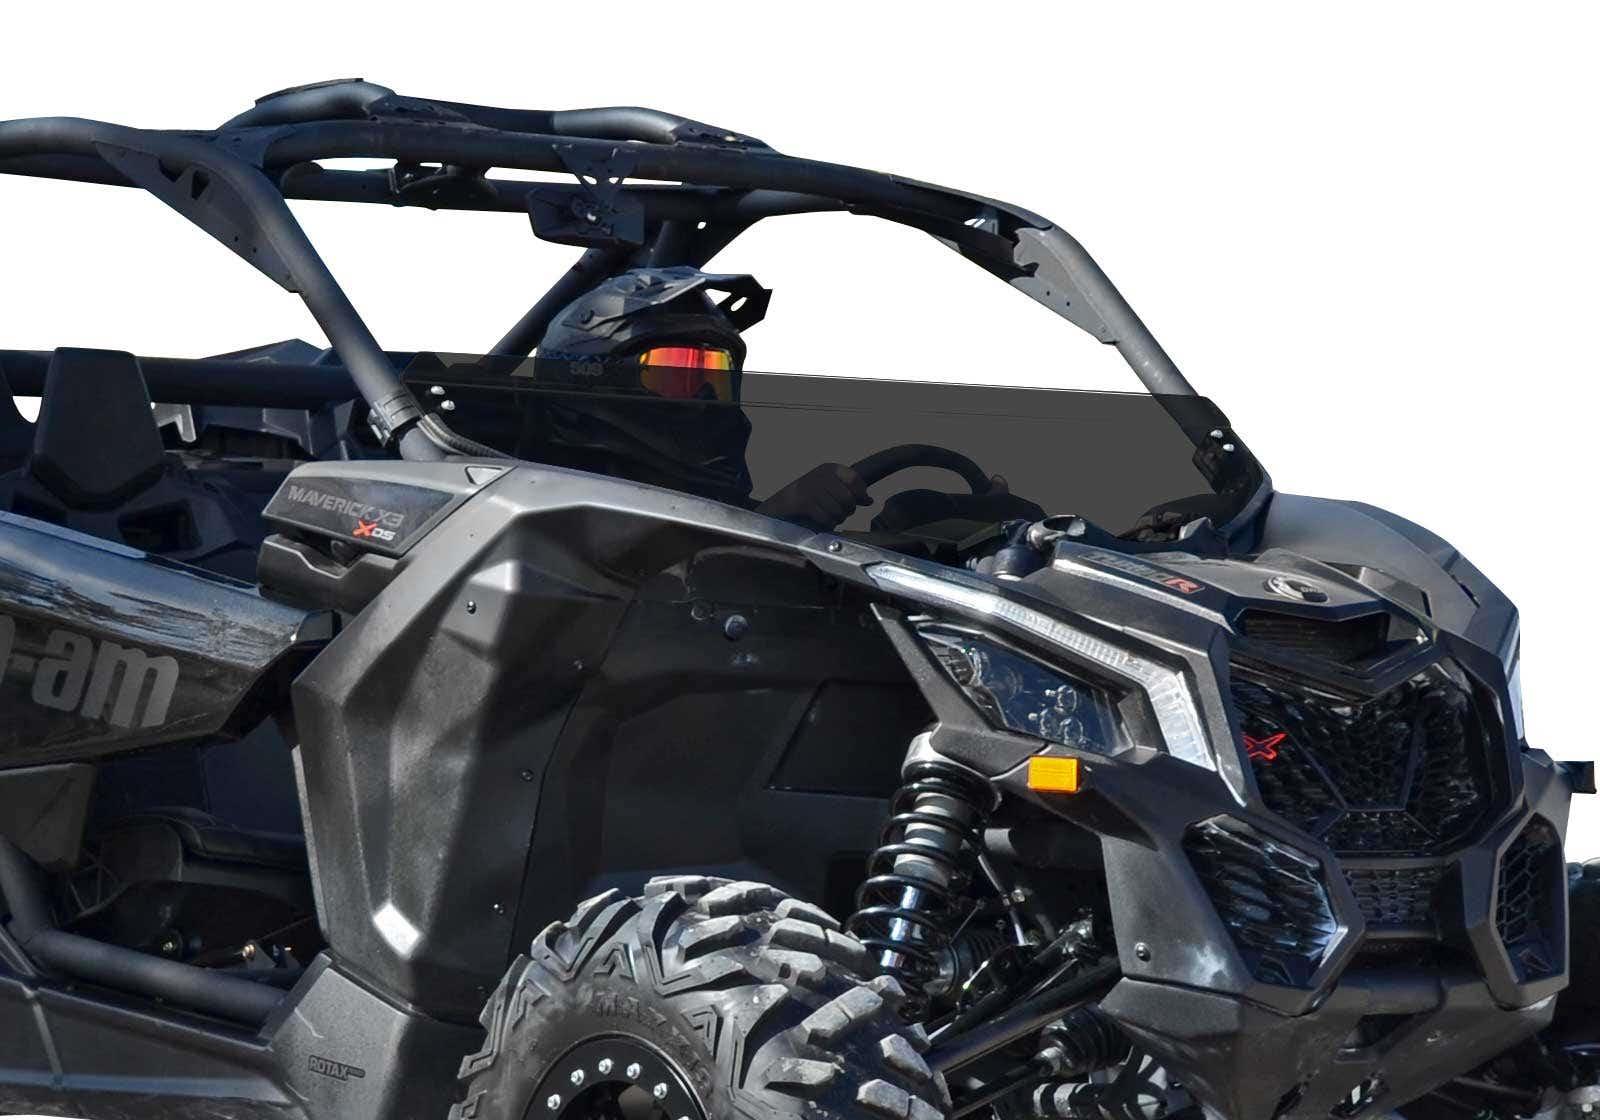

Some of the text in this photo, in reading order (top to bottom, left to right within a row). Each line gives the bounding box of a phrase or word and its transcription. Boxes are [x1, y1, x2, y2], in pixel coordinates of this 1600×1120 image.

[287, 485, 404, 528] MAVERICK X3
[308, 1055, 349, 1081] ROTAX
